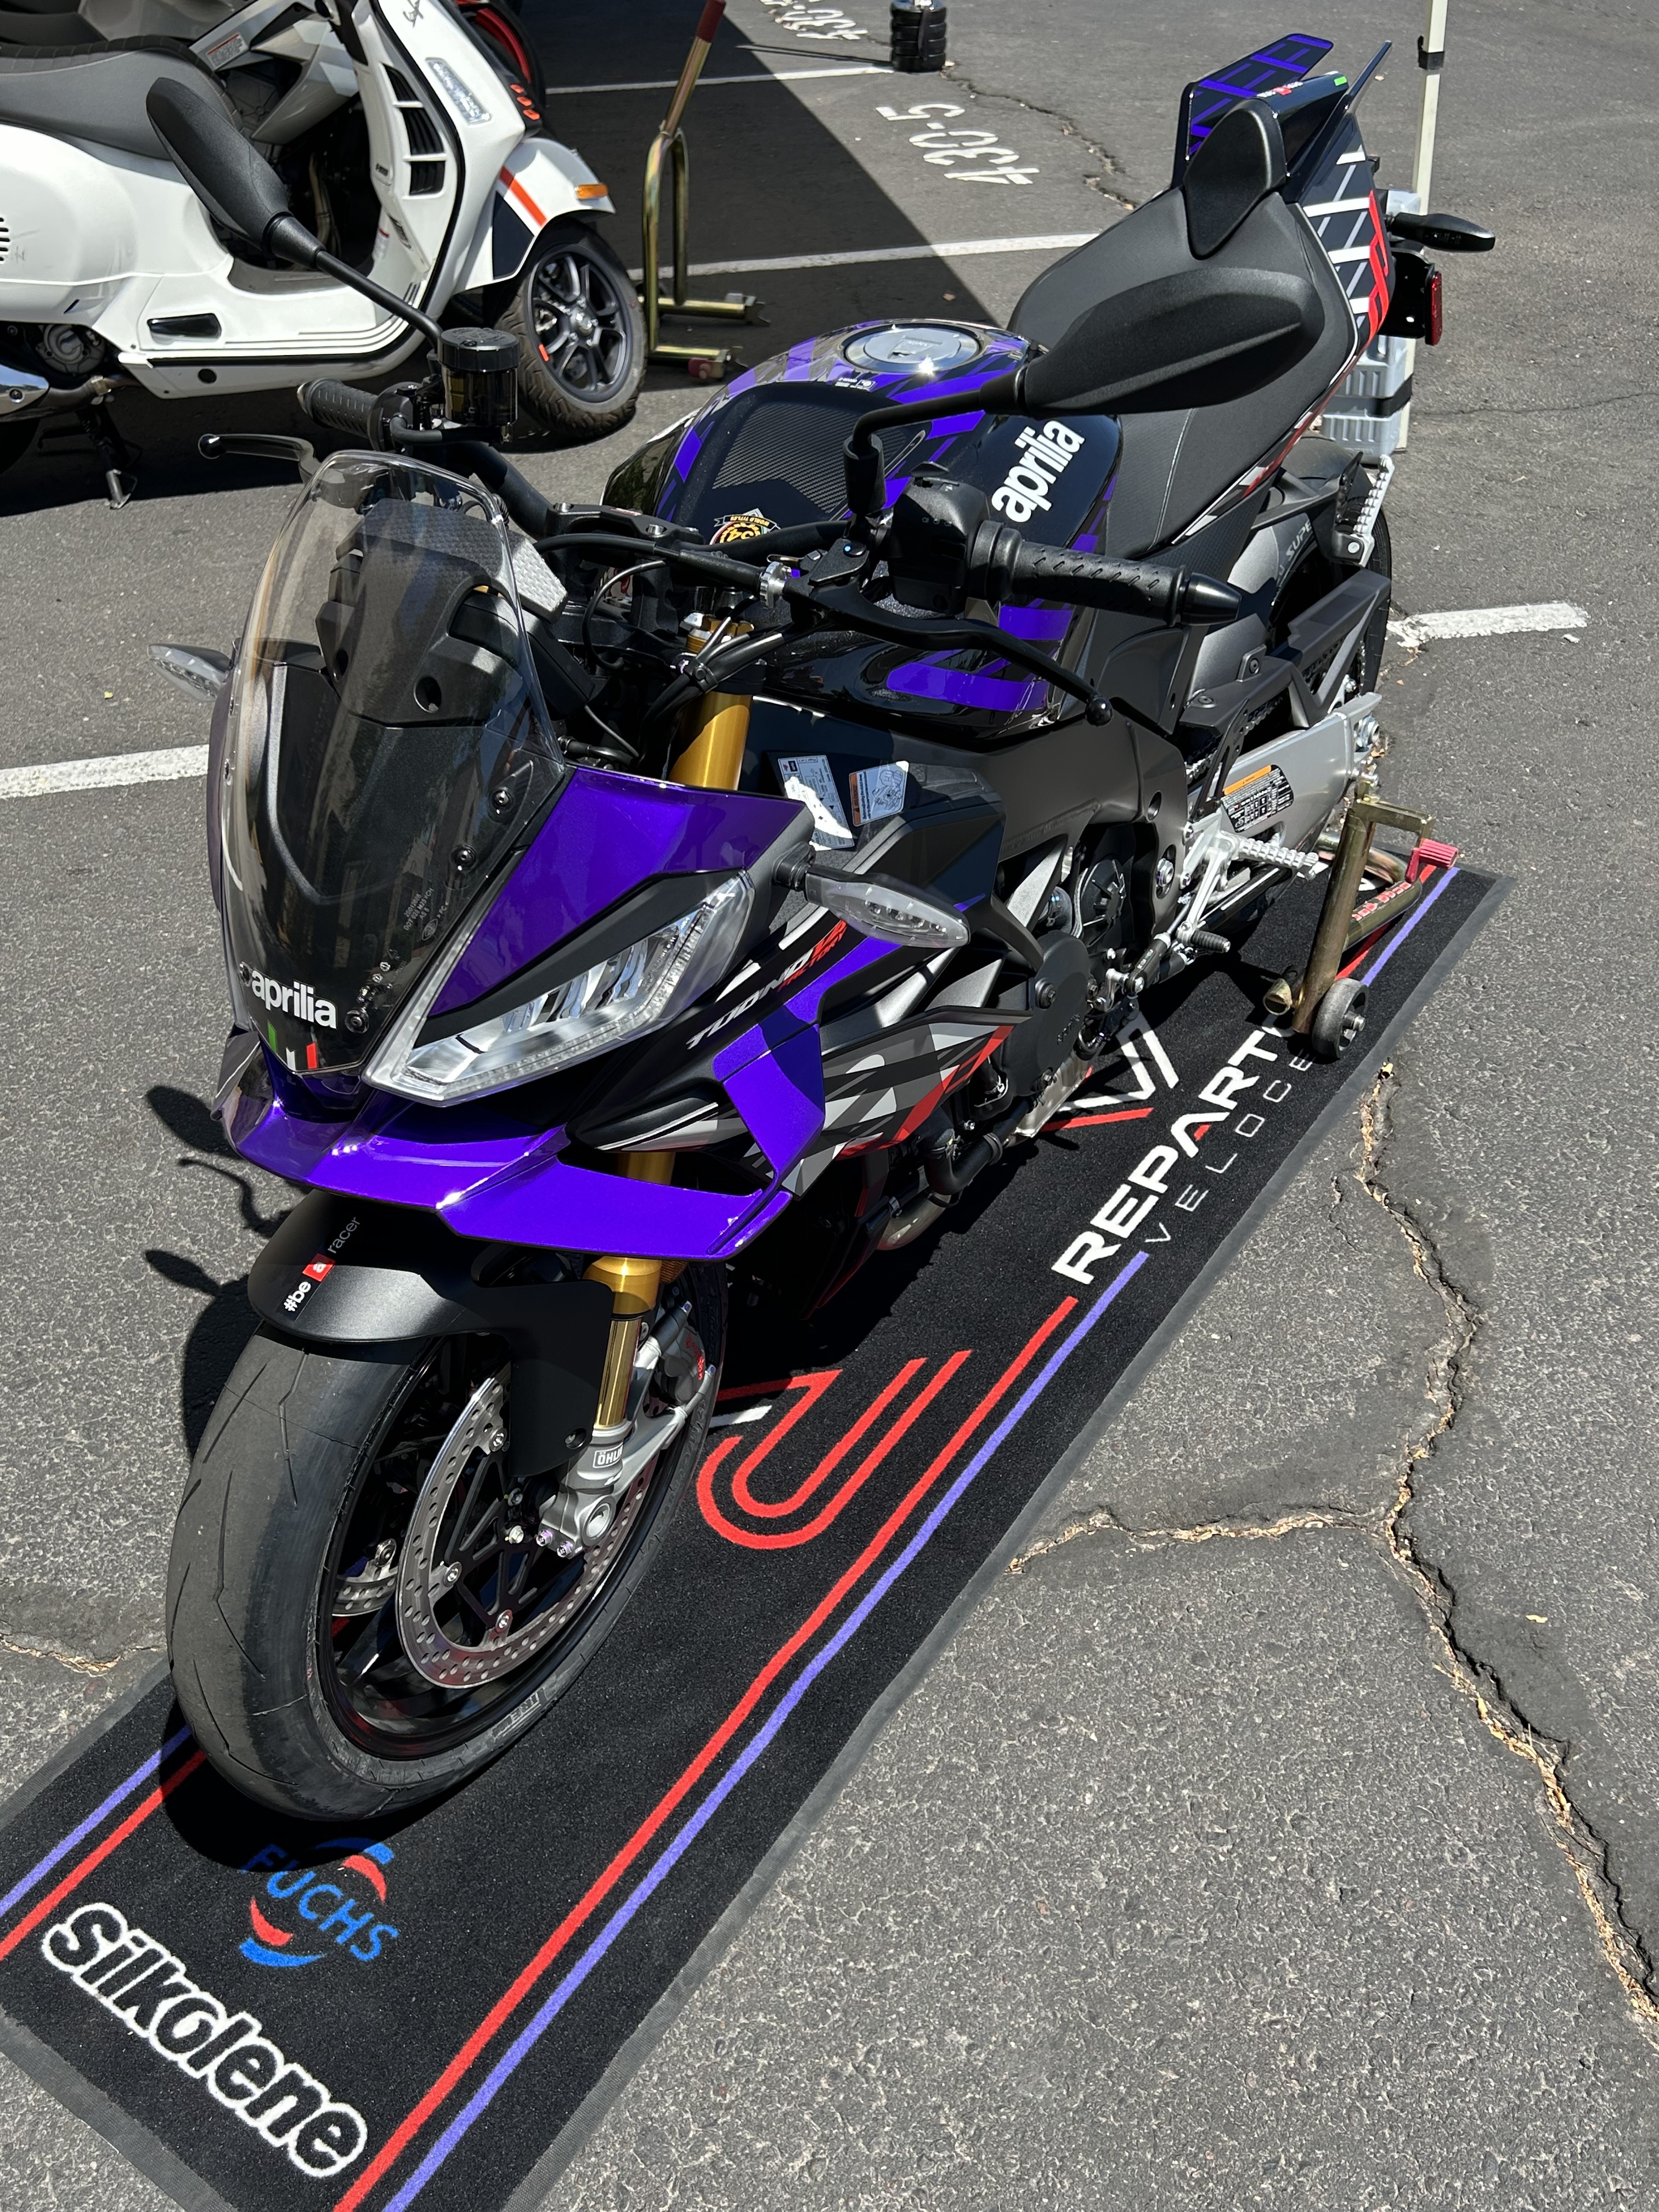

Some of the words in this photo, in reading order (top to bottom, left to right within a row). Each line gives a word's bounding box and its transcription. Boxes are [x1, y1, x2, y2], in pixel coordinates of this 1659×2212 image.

[875, 103, 1040, 185] 430-5
[991, 420, 1085, 522] aprilia
[1286, 519, 1312, 562] SUPE
[404, 918, 414, 931] DOT
[252, 969, 337, 1024] aprilia
[685, 948, 814, 1050] TUONO
[1144, 1048, 1316, 1244] VELOCE
[283, 1281, 312, 1312] #be
[328, 1216, 360, 1254] racer
[597, 1444, 623, 1465] ÖHLI
[240, 1844, 399, 1961] FUCHS
[42, 1902, 368, 2179] Silkolene
